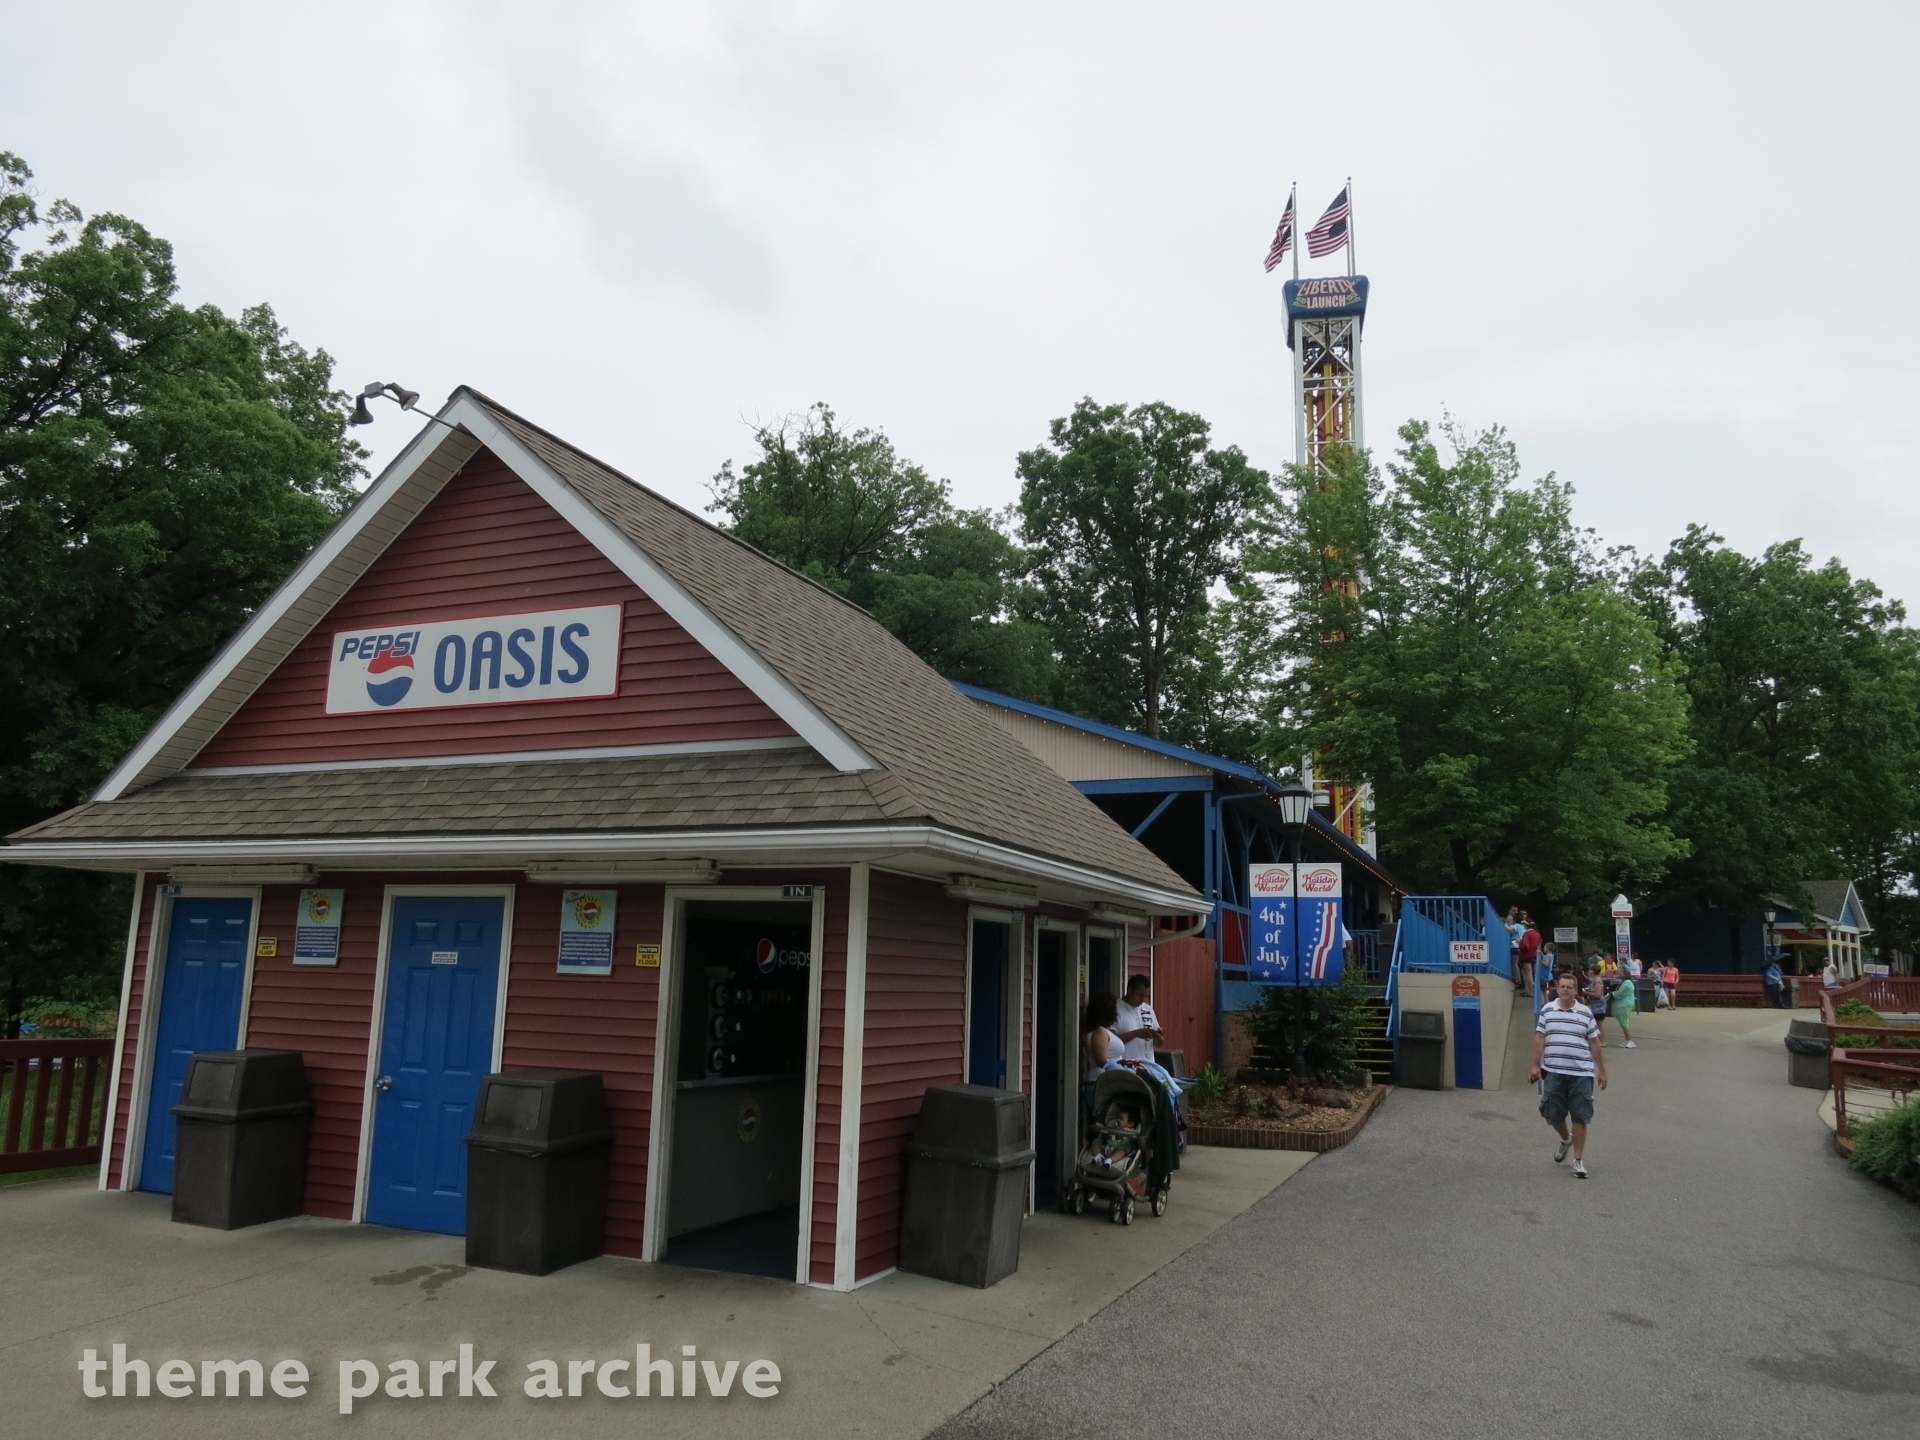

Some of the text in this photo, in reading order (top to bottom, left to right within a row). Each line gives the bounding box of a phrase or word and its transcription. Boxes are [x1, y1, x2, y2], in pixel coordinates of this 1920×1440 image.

[1297, 279, 1355, 296] LIBERTY
[1307, 295, 1346, 309] LAUNCH
[339, 631, 421, 662] PEPSI
[433, 622, 590, 694] OASIS
[1255, 873, 1290, 885] Holiday
[1302, 873, 1338, 885] Holiday
[790, 886, 806, 896] IN
[1255, 882, 1284, 892] World
[1302, 882, 1331, 893] World
[1259, 906, 1285, 926] 4th
[1265, 930, 1281, 944] of
[779, 949, 812, 969] peps
[1256, 946, 1289, 971] July
[1457, 952, 1482, 960] HERE
